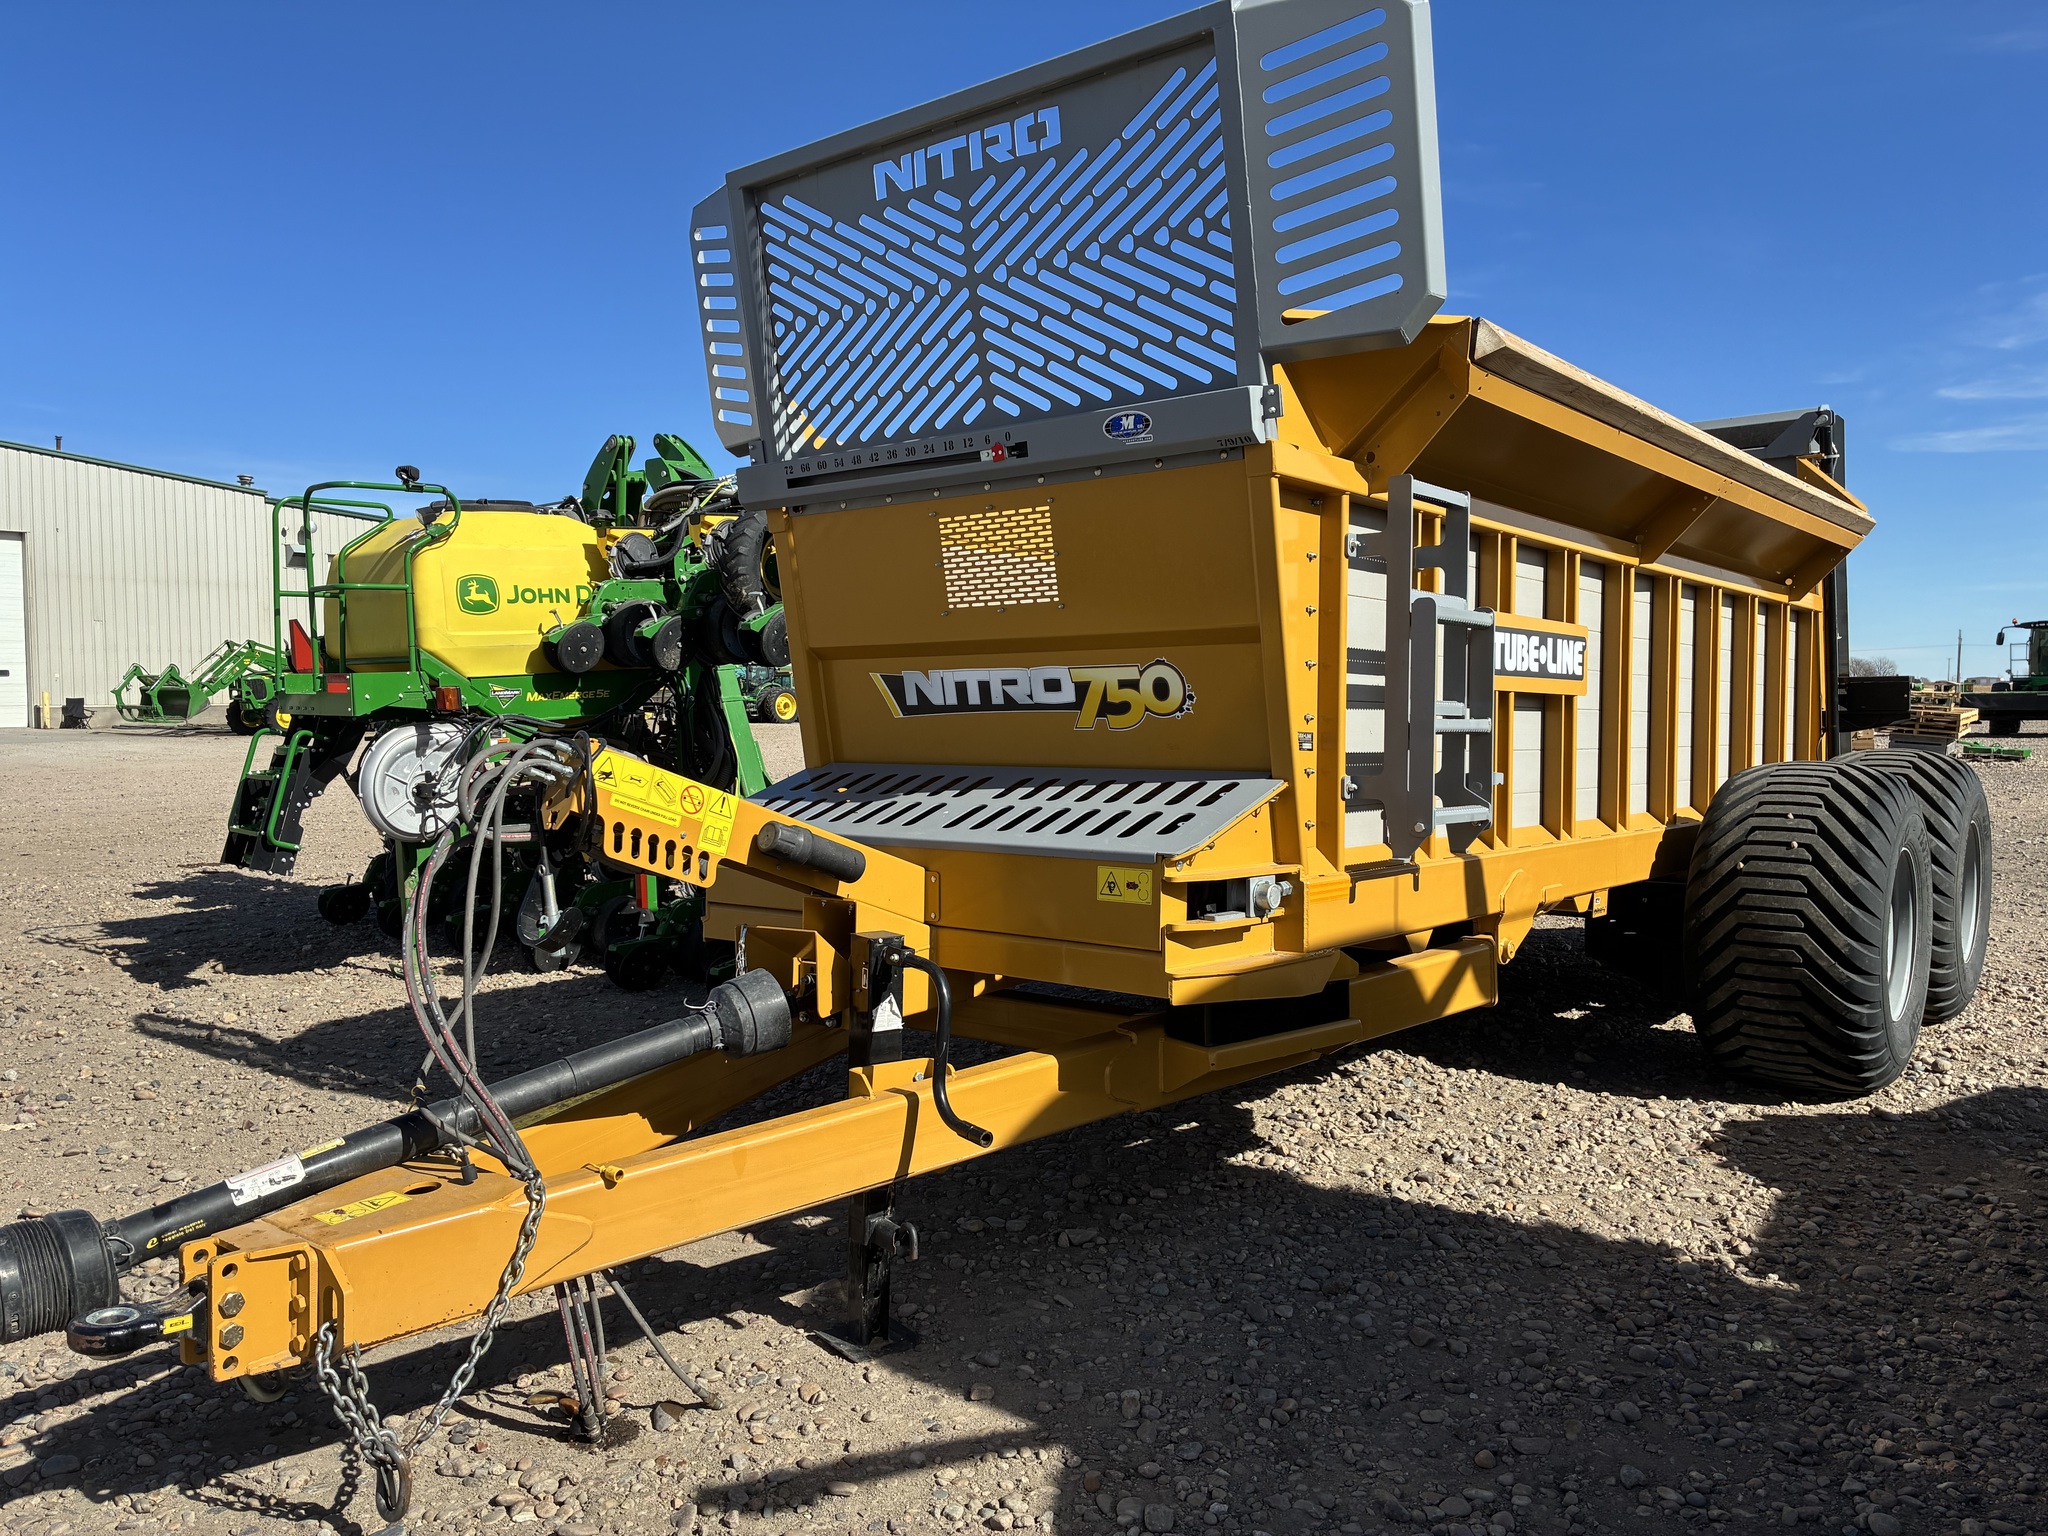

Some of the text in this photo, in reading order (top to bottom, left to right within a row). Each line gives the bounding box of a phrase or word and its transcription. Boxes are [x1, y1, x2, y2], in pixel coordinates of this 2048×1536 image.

[873, 105, 1062, 201] NITRO
[784, 431, 1011, 475] 72 66 60 54 48 42 36 30 24 18 12 6 0
[1216, 435, 1252, 447] 7/9/10
[506, 585, 571, 604] JOHN
[903, 663, 1184, 730] NITRO 750
